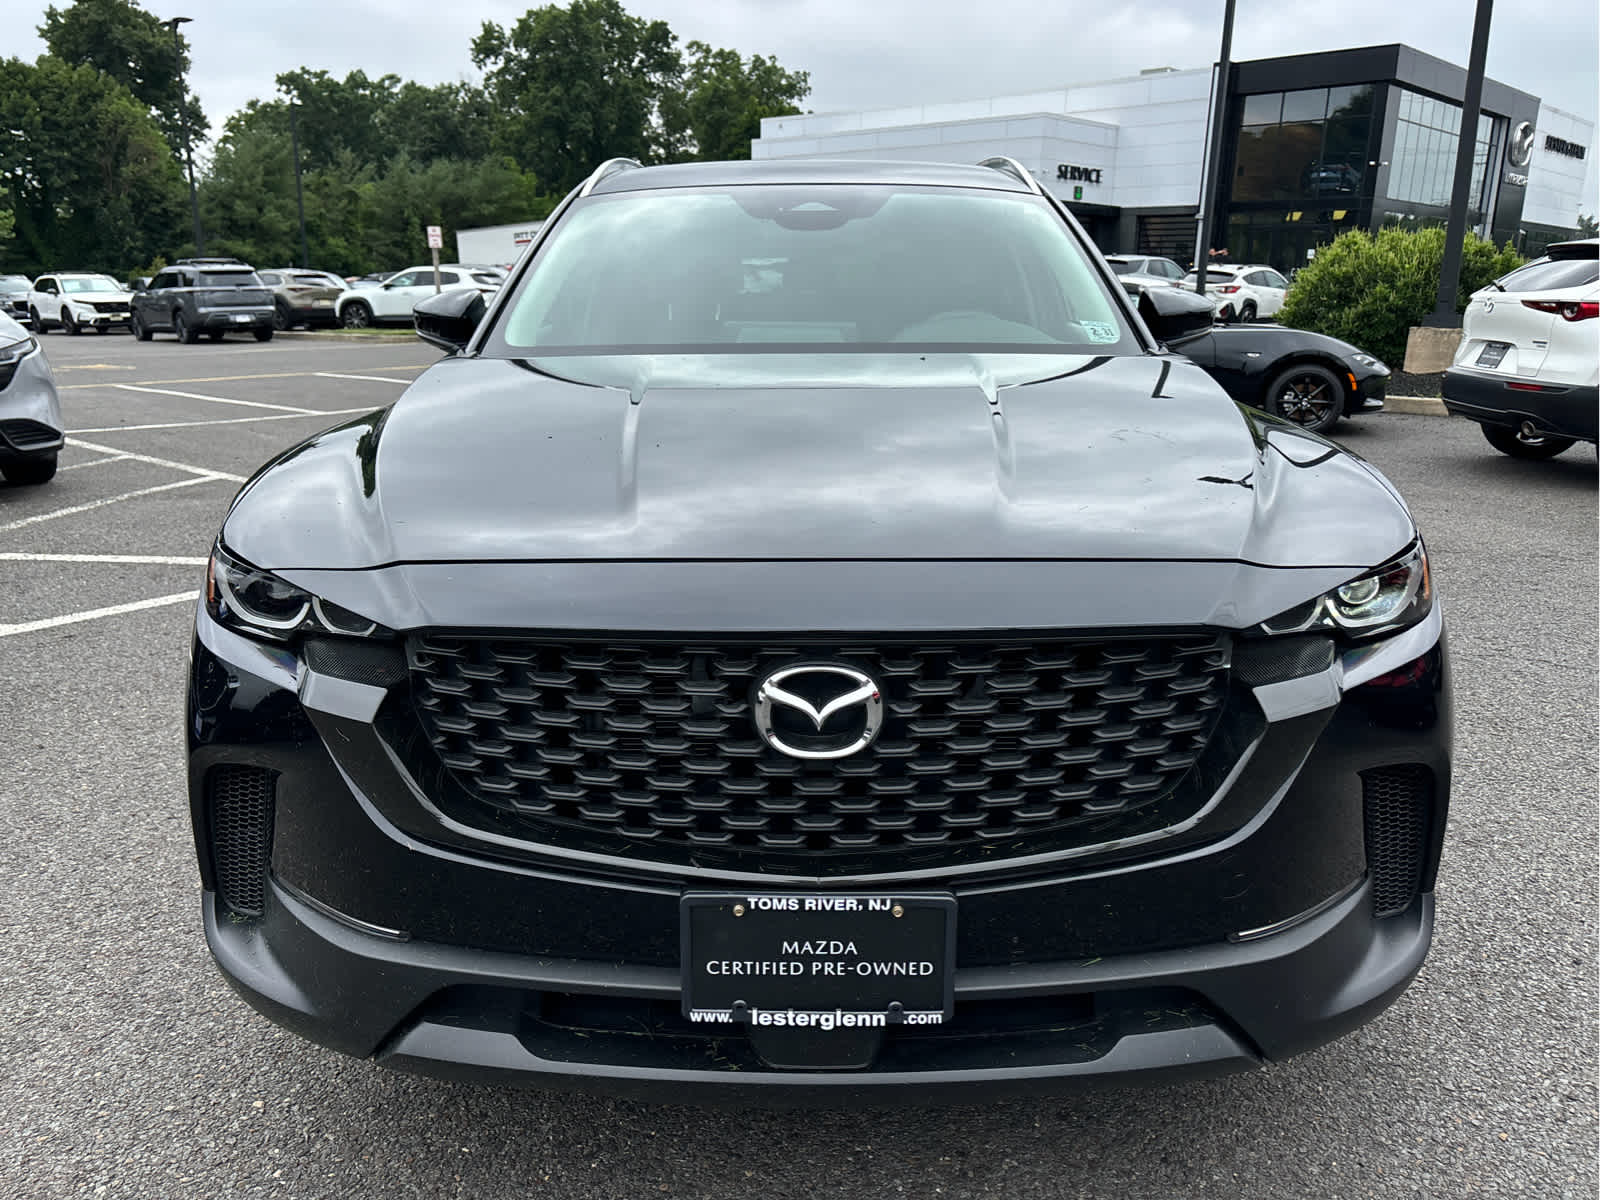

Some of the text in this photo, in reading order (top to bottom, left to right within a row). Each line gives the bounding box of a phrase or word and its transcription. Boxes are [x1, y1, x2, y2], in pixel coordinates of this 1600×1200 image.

[1057, 163, 1103, 184] SERVICE
[747, 898, 892, 912] TOMS RIVER, NJ
[781, 941, 858, 956] MAZDA
[706, 960, 934, 976] CERTIFIED PRE-OWNED
[689, 1008, 942, 1031] www. lesterglenn .com
